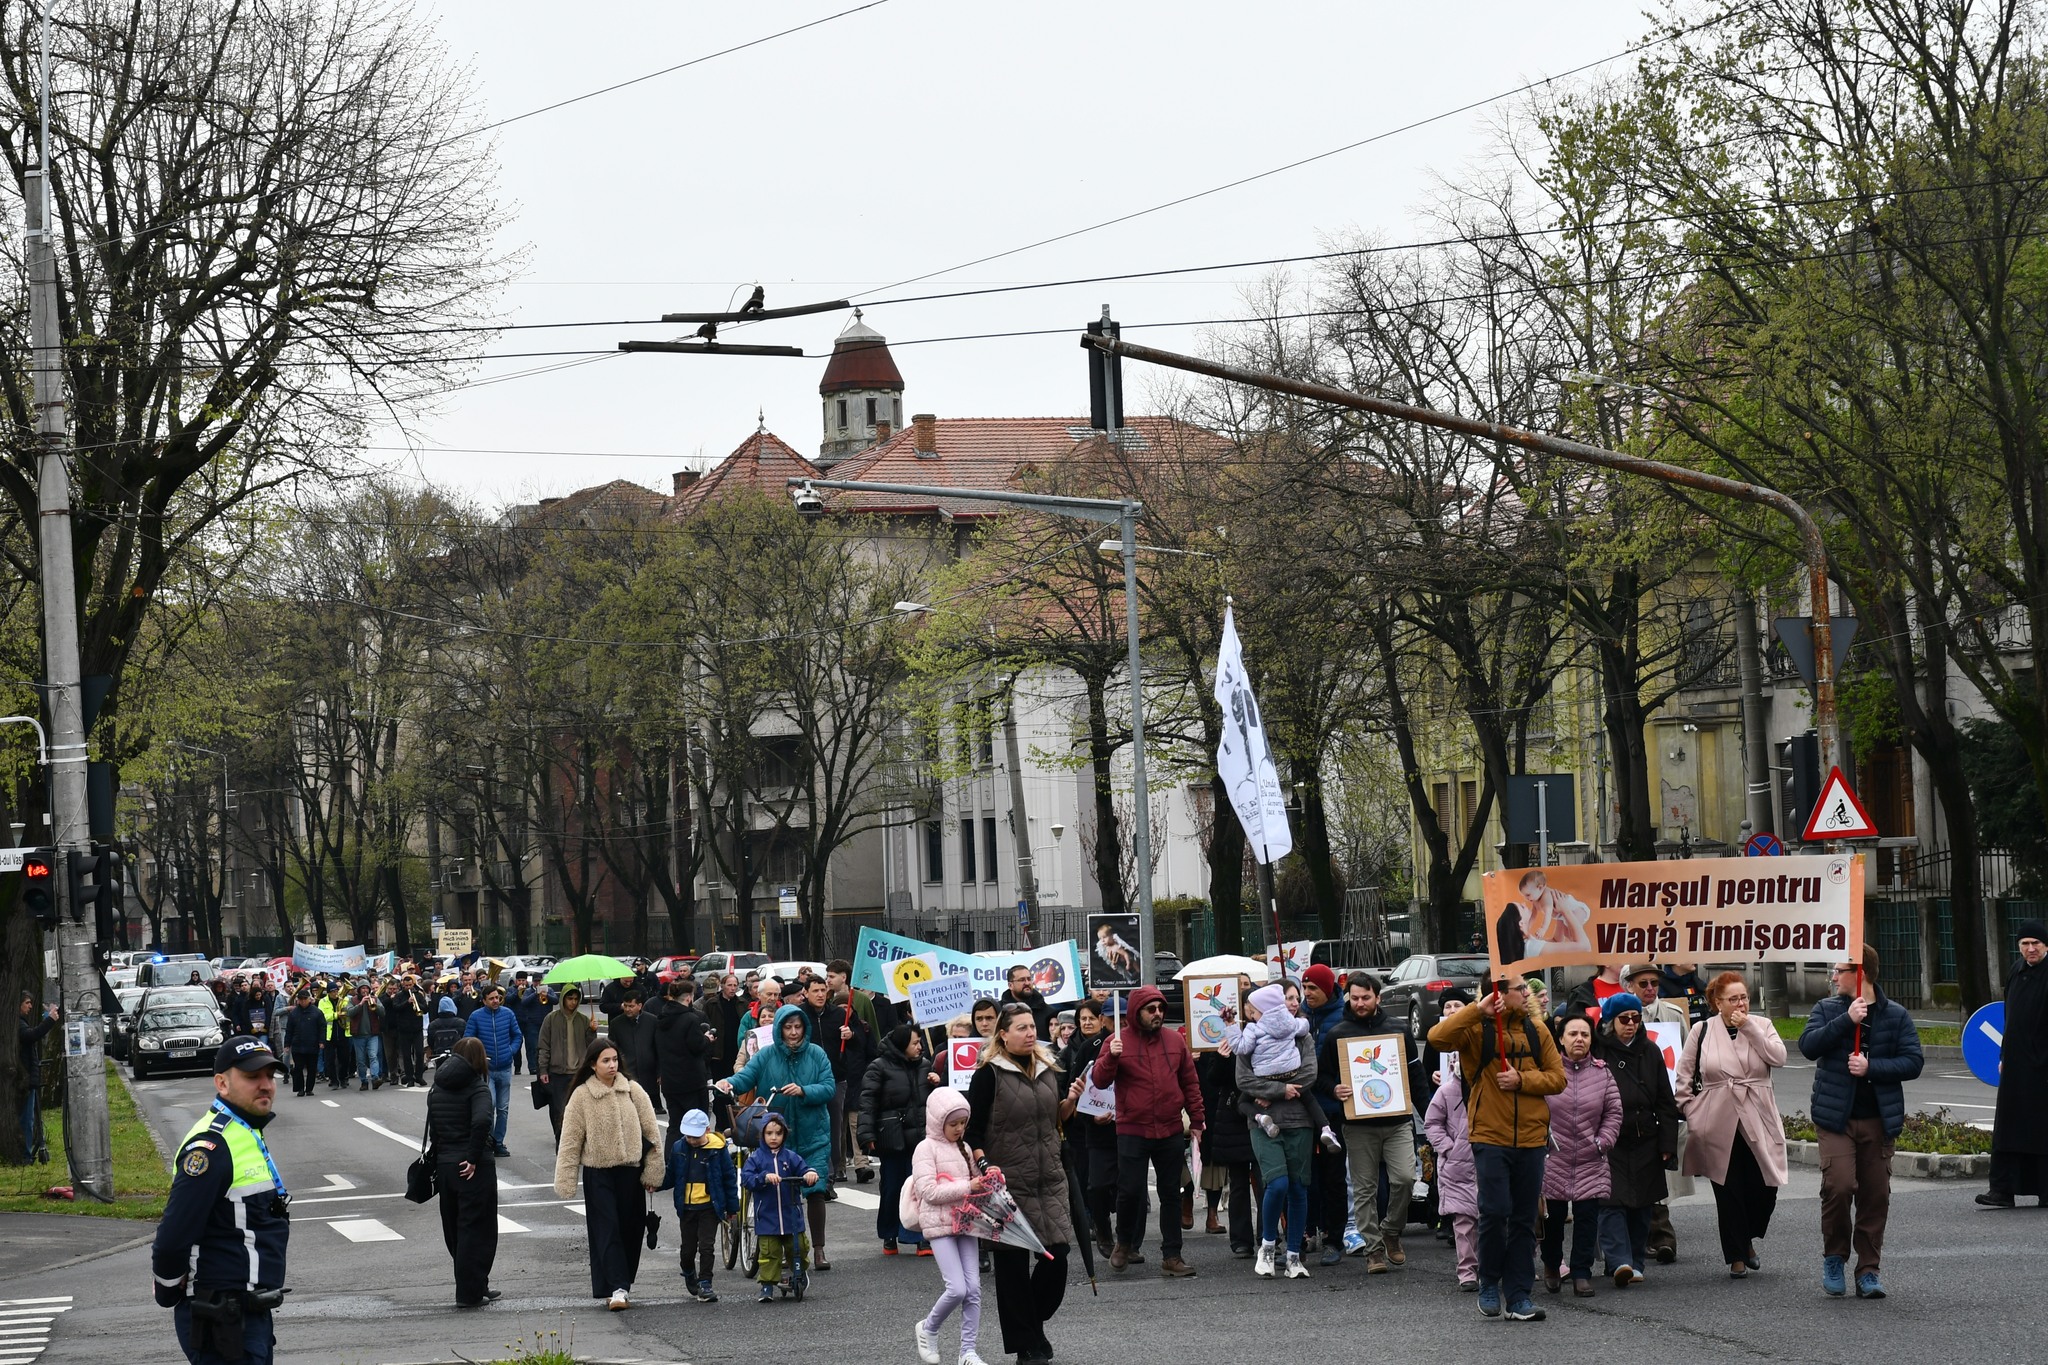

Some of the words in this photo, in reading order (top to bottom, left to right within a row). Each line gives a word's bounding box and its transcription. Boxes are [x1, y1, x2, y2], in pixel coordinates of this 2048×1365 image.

[1600, 875, 1709, 916] Marșul
[1716, 874, 1822, 909] pentru
[867, 939, 888, 960] Să
[1596, 919, 1678, 962] Viață
[1685, 918, 1846, 959] Timișoara
[913, 989, 930, 999] THE
[930, 981, 968, 995] PRO-LIFE
[916, 991, 969, 1008] GENERATION
[925, 1001, 964, 1016] ROMANIA
